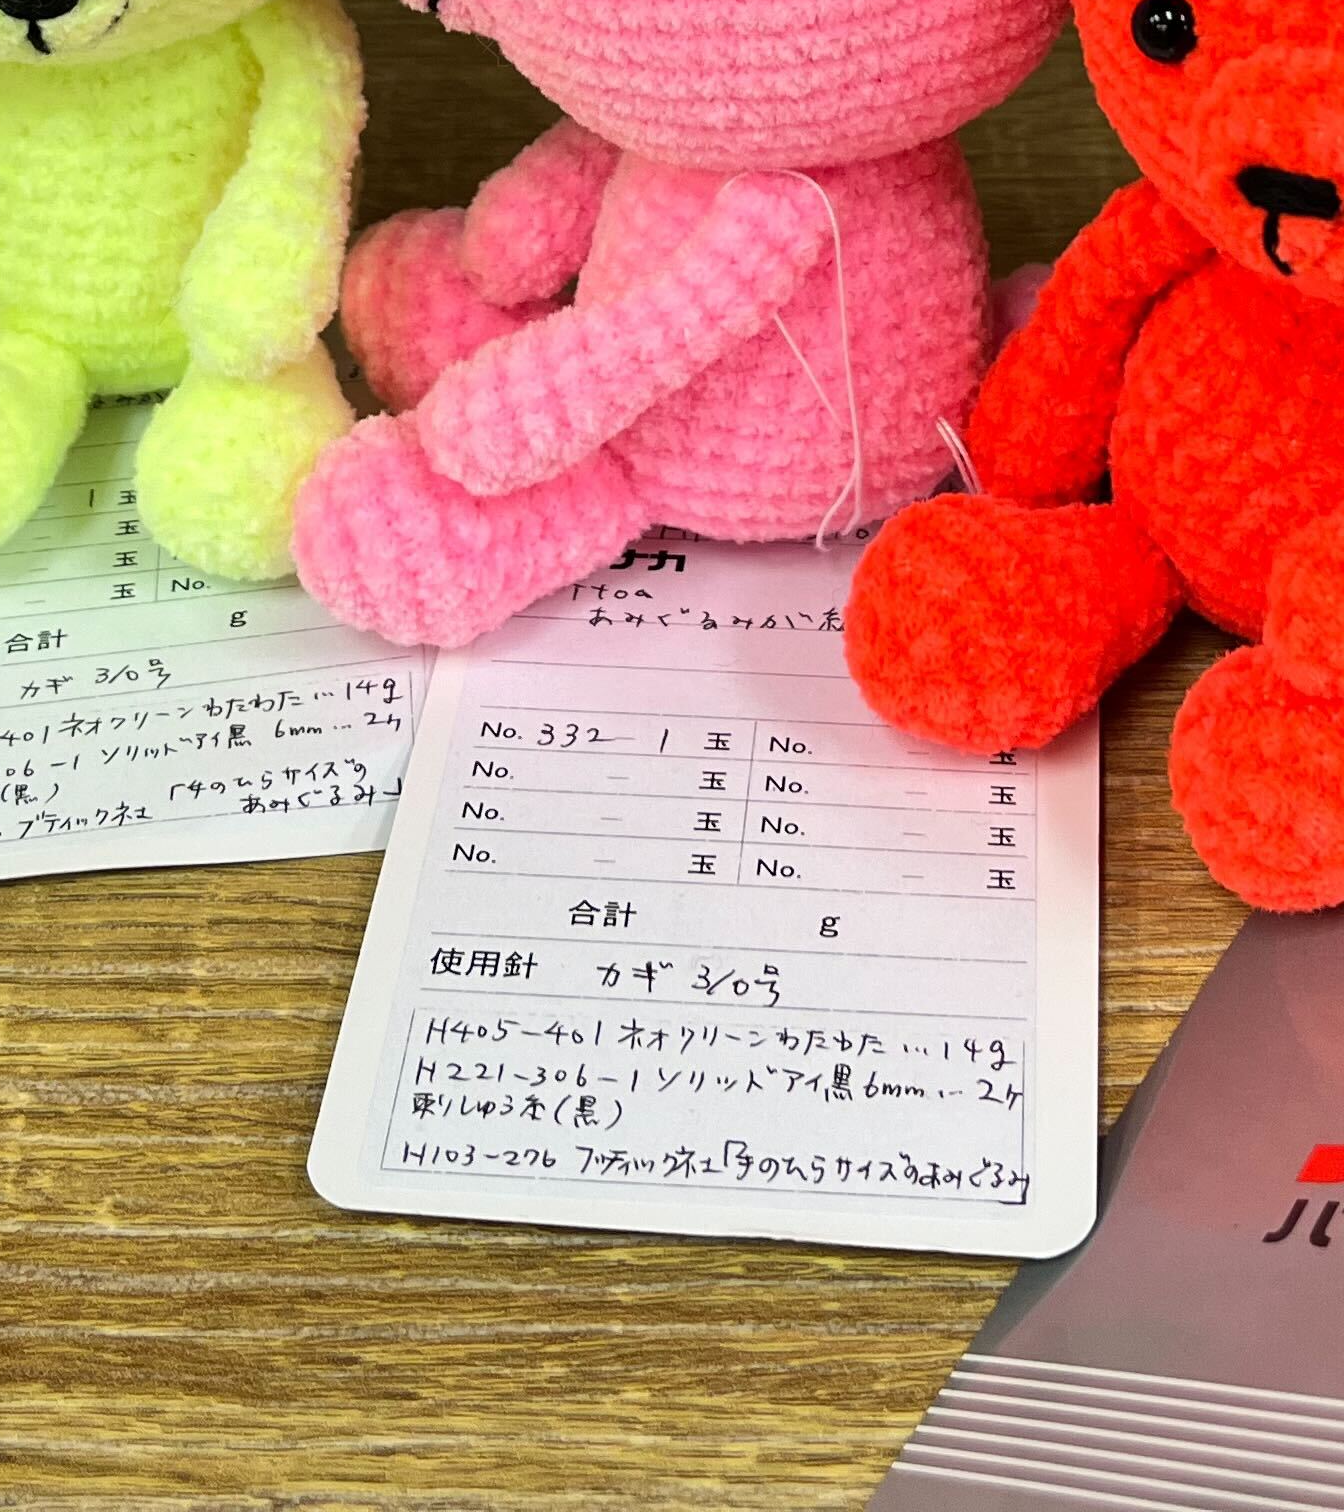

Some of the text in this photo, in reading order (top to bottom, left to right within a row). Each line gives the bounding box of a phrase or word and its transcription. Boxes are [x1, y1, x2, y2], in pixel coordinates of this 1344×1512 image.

[114, 519, 140, 536] 玉
[111, 550, 139, 568] 玉
[609, 548, 686, 572] ナカ
[109, 577, 211, 600] 玉 No.
[5, 609, 248, 654] 合計 g
[480, 721, 522, 739] No.
[704, 732, 732, 751] 玉
[769, 736, 812, 755] No.
[472, 761, 1016, 805] No. 玉 No. 玉
[462, 802, 1016, 847] No. 玉 No. 玉
[452, 844, 1016, 889] No. 玉 No. 玉
[569, 900, 841, 938] 合計 g
[430, 947, 538, 980] 使用針
[426, 1017, 602, 1045] H405-401
[415, 1056, 639, 1093] H221-306-1
[403, 1141, 557, 1167] H103-276
